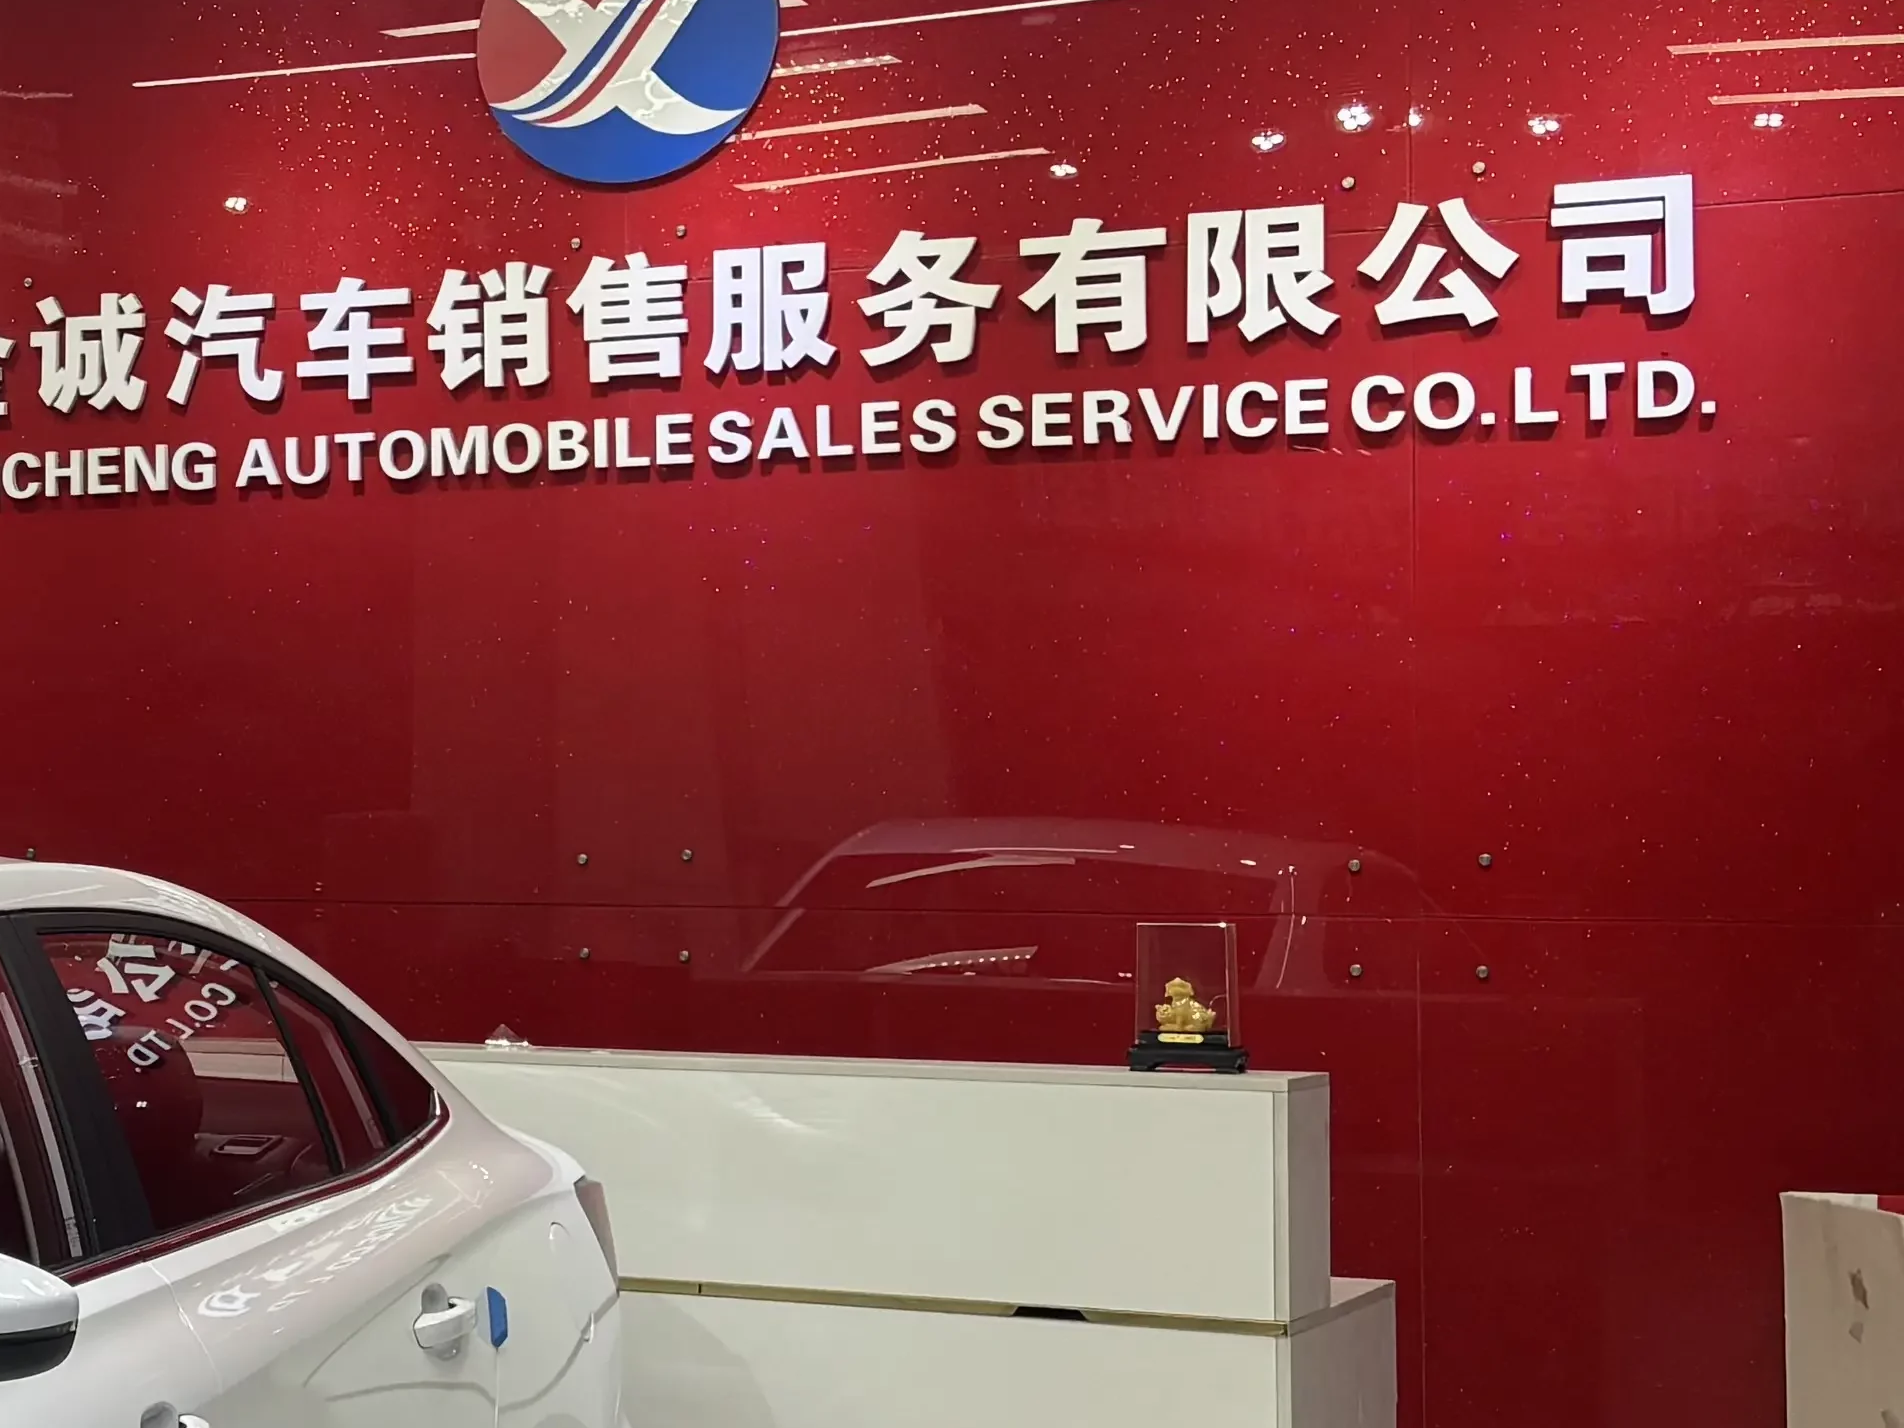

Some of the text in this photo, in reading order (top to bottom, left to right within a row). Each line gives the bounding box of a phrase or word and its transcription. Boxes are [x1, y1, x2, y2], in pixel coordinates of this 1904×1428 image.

[235, 410, 695, 489] AUTOMOBILE
[708, 398, 957, 465] SALES
[976, 376, 1331, 451] SERVICE
